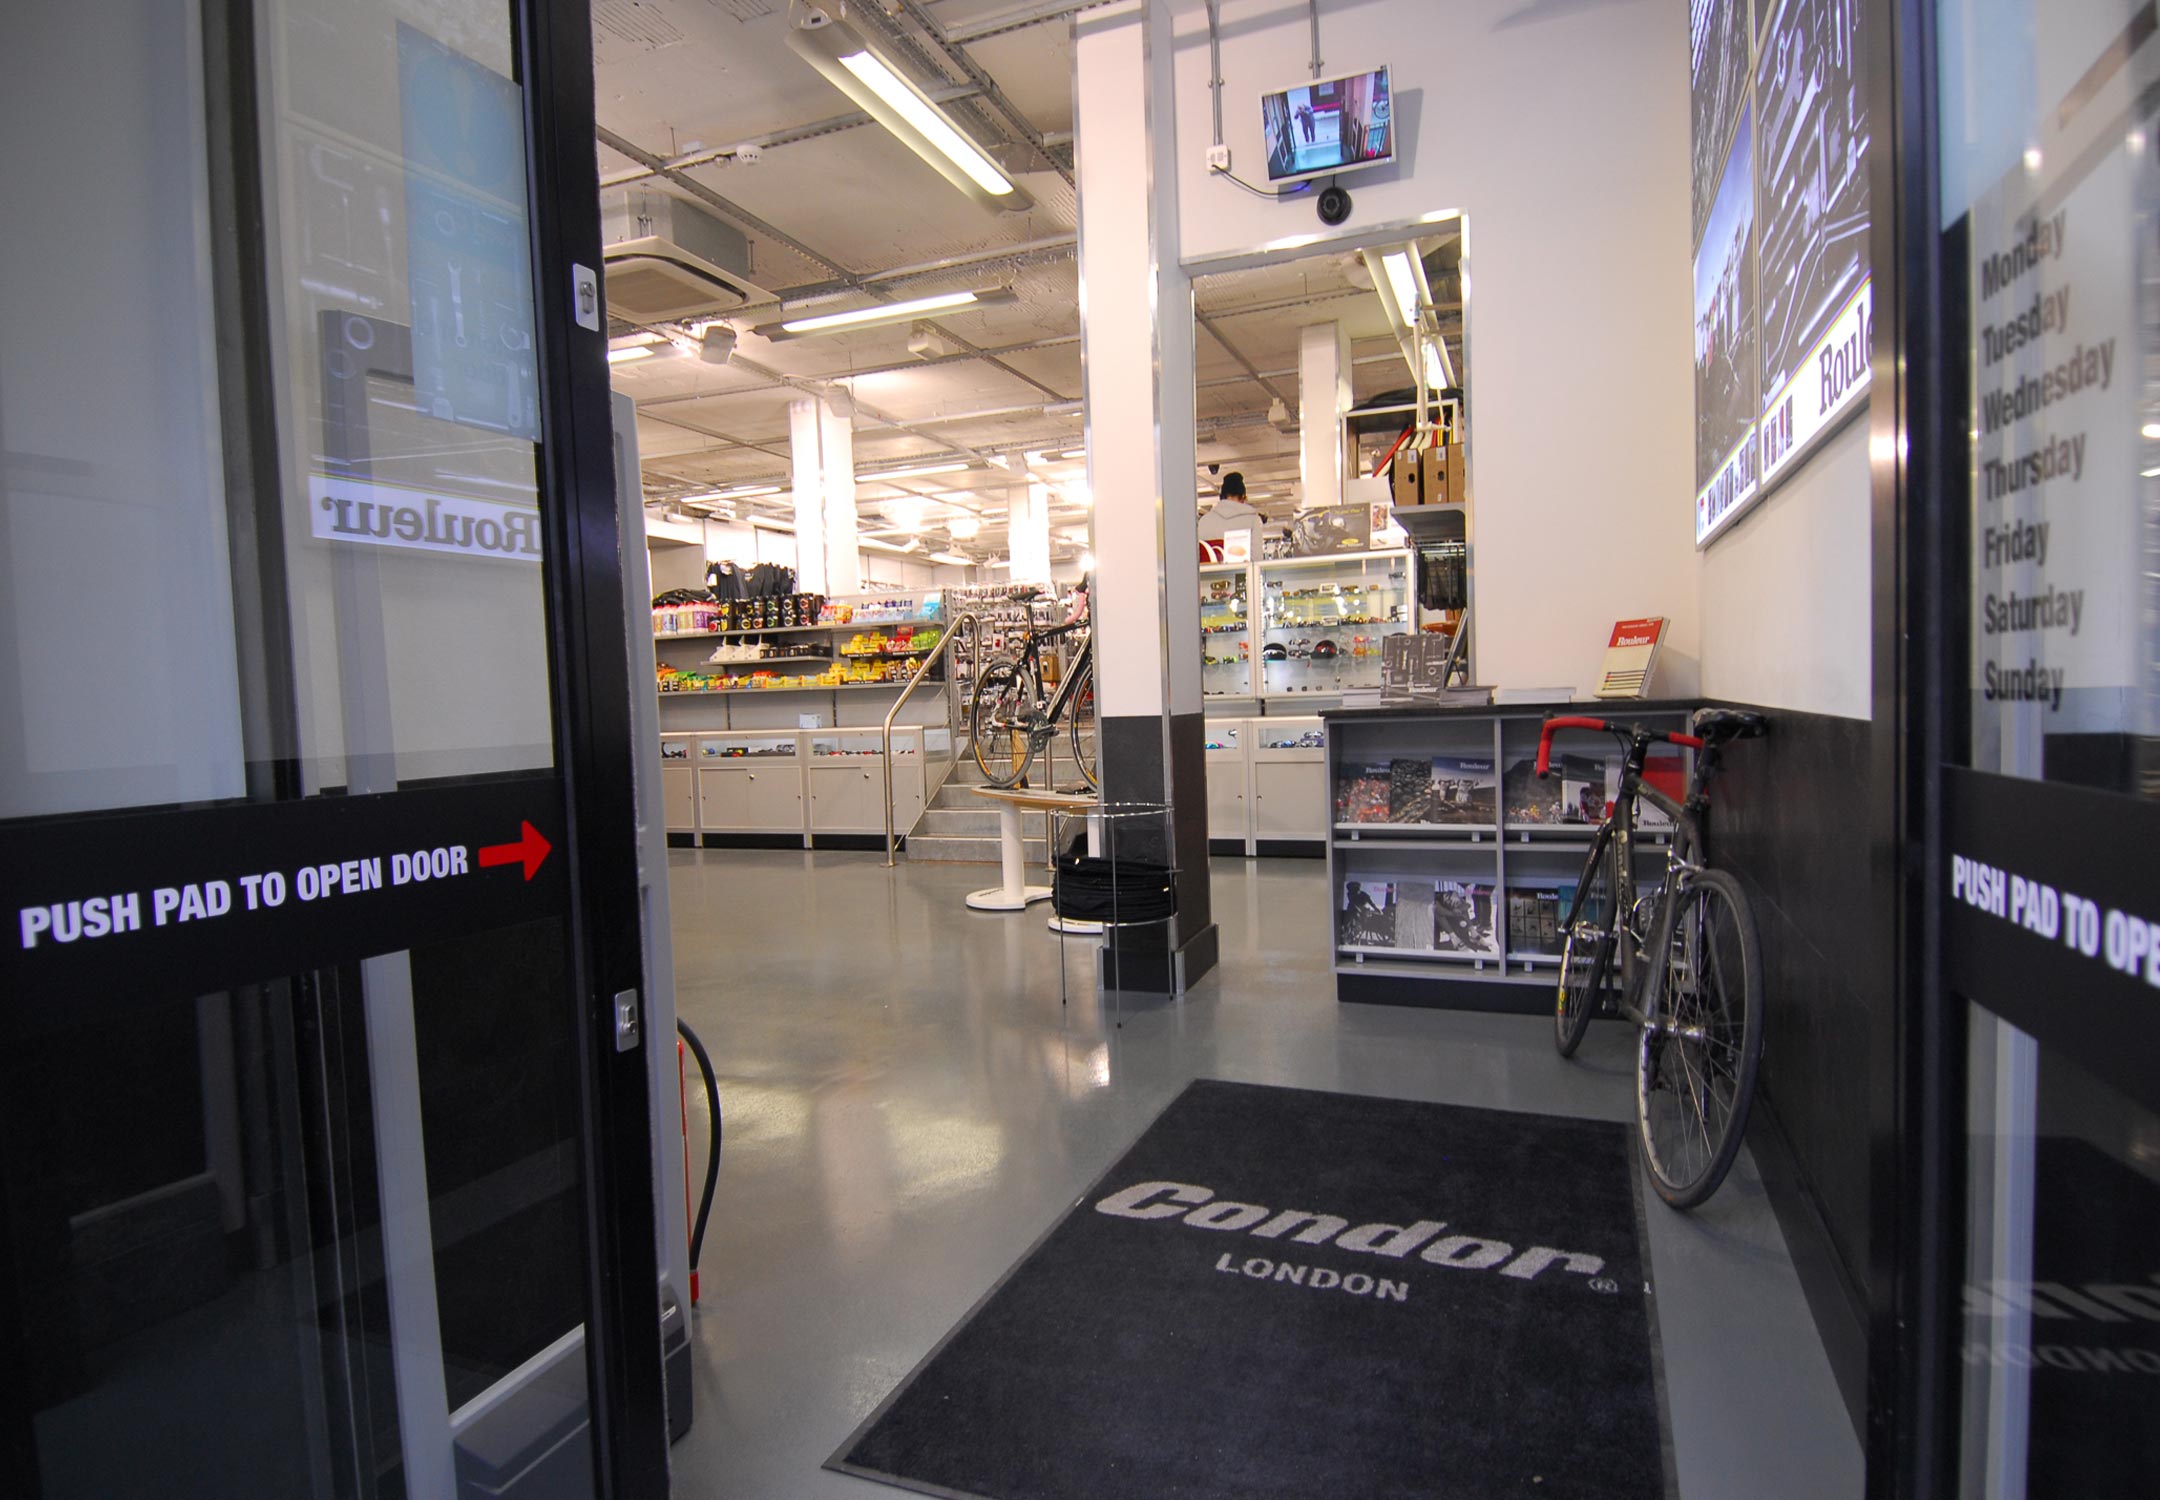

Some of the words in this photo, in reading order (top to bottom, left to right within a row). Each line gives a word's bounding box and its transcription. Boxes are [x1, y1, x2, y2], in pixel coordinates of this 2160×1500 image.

[1982, 208, 2067, 301] Monday
[1982, 284, 2071, 367] Tuesday
[1983, 337, 2116, 434] Wednesday
[1984, 432, 2087, 501] Thursday
[1984, 519, 2050, 570] Friday
[1617, 636, 1650, 646] Rouleur
[1984, 584, 2085, 636] Saturday
[1984, 659, 2065, 712] Sunday
[19, 892, 141, 949] PUSH
[153, 880, 231, 926] PAD
[240, 871, 286, 910] TO
[298, 857, 382, 901] OPEN
[391, 845, 469, 886] DOOR
[1953, 854, 2007, 918] PUSH
[2011, 874, 2060, 940] PAD
[2063, 891, 2100, 957] TO
[1096, 1181, 1605, 1280] Condor
[1215, 1252, 1409, 1302] LONDON
